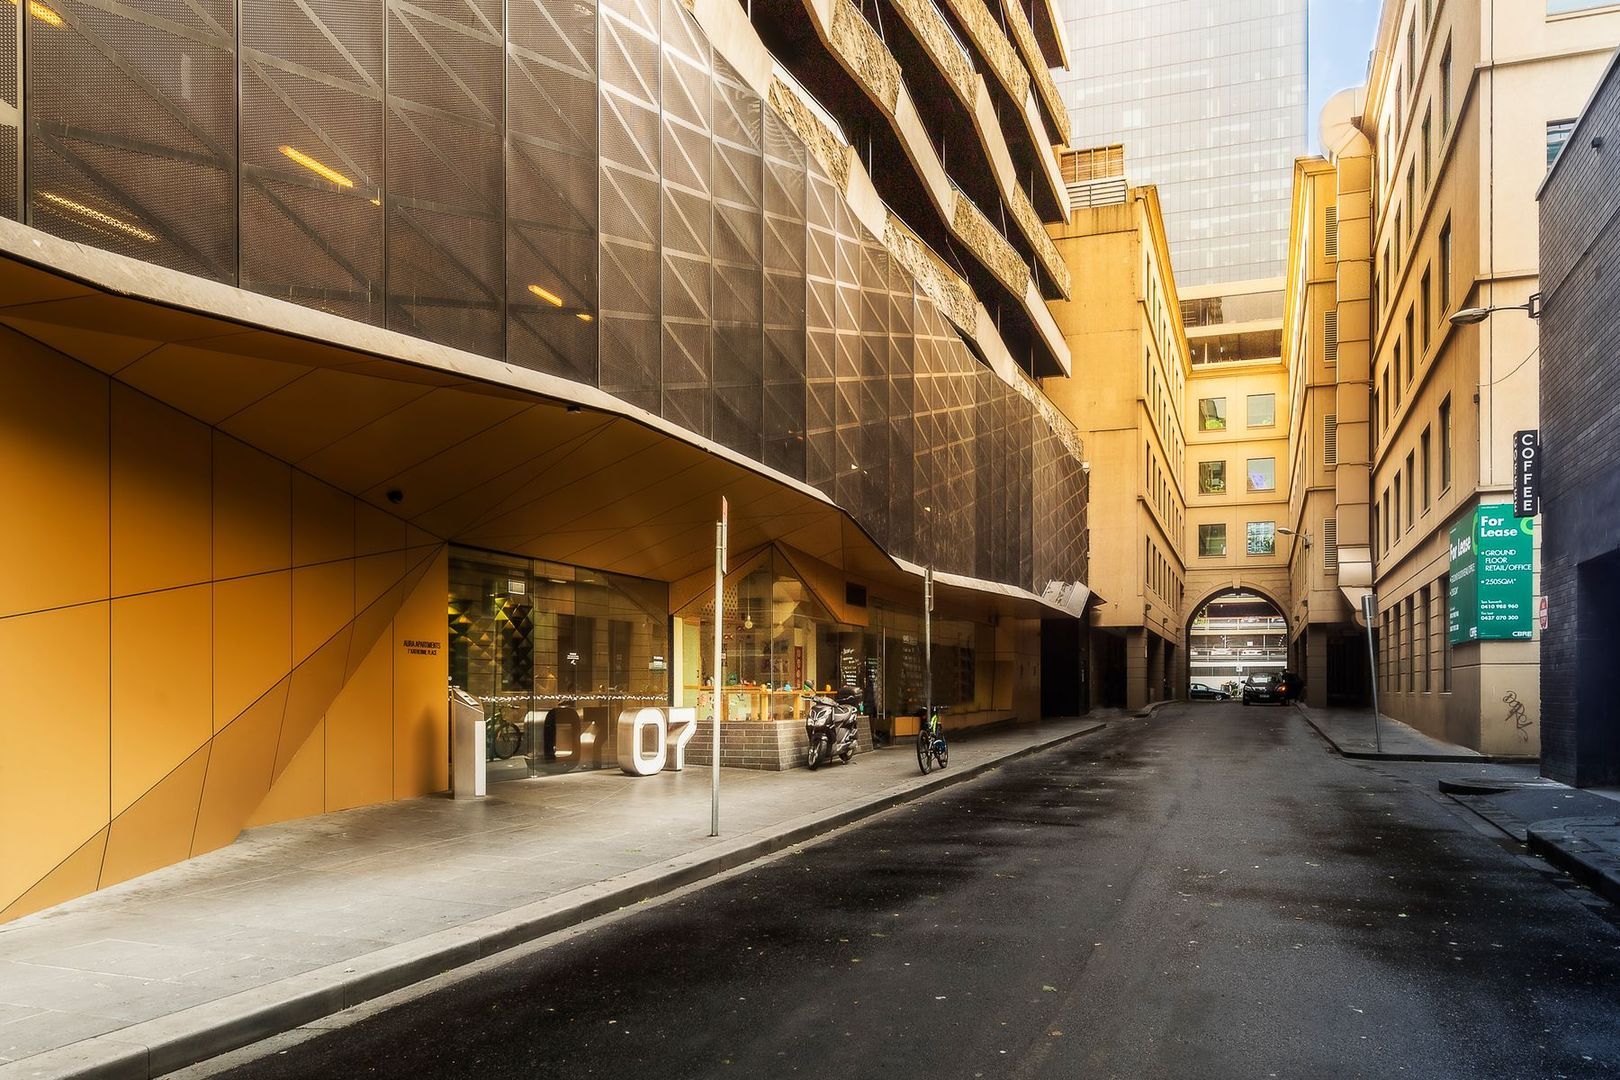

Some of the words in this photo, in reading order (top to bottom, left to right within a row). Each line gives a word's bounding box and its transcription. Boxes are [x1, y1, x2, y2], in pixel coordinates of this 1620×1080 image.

[1522, 434, 1534, 511] COFFEE
[1481, 516, 1504, 527] For
[1481, 528, 1518, 537] Lease
[618, 707, 697, 776] 07
